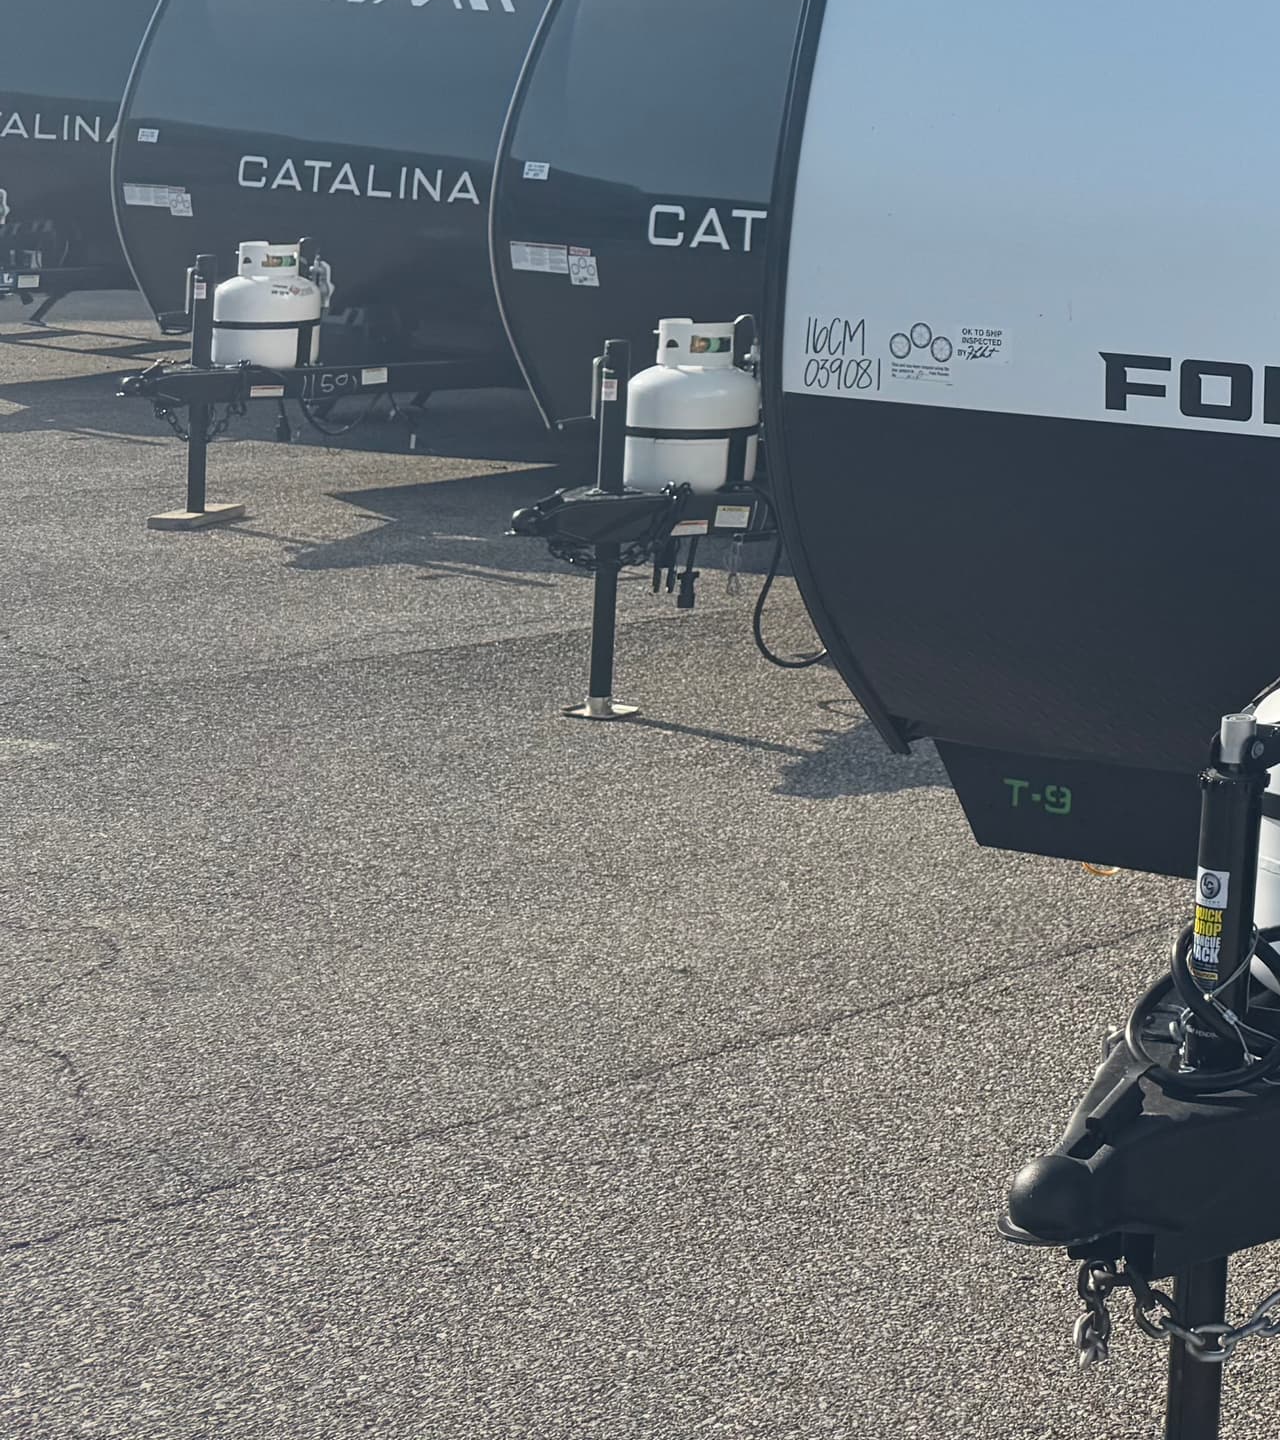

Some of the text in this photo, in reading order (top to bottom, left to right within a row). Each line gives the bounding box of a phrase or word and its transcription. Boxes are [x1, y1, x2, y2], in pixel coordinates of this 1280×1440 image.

[0, 111, 118, 143] ALIN
[238, 155, 480, 205] CATALINA
[648, 204, 767, 252] CAT
[804, 356, 881, 390] 039081
